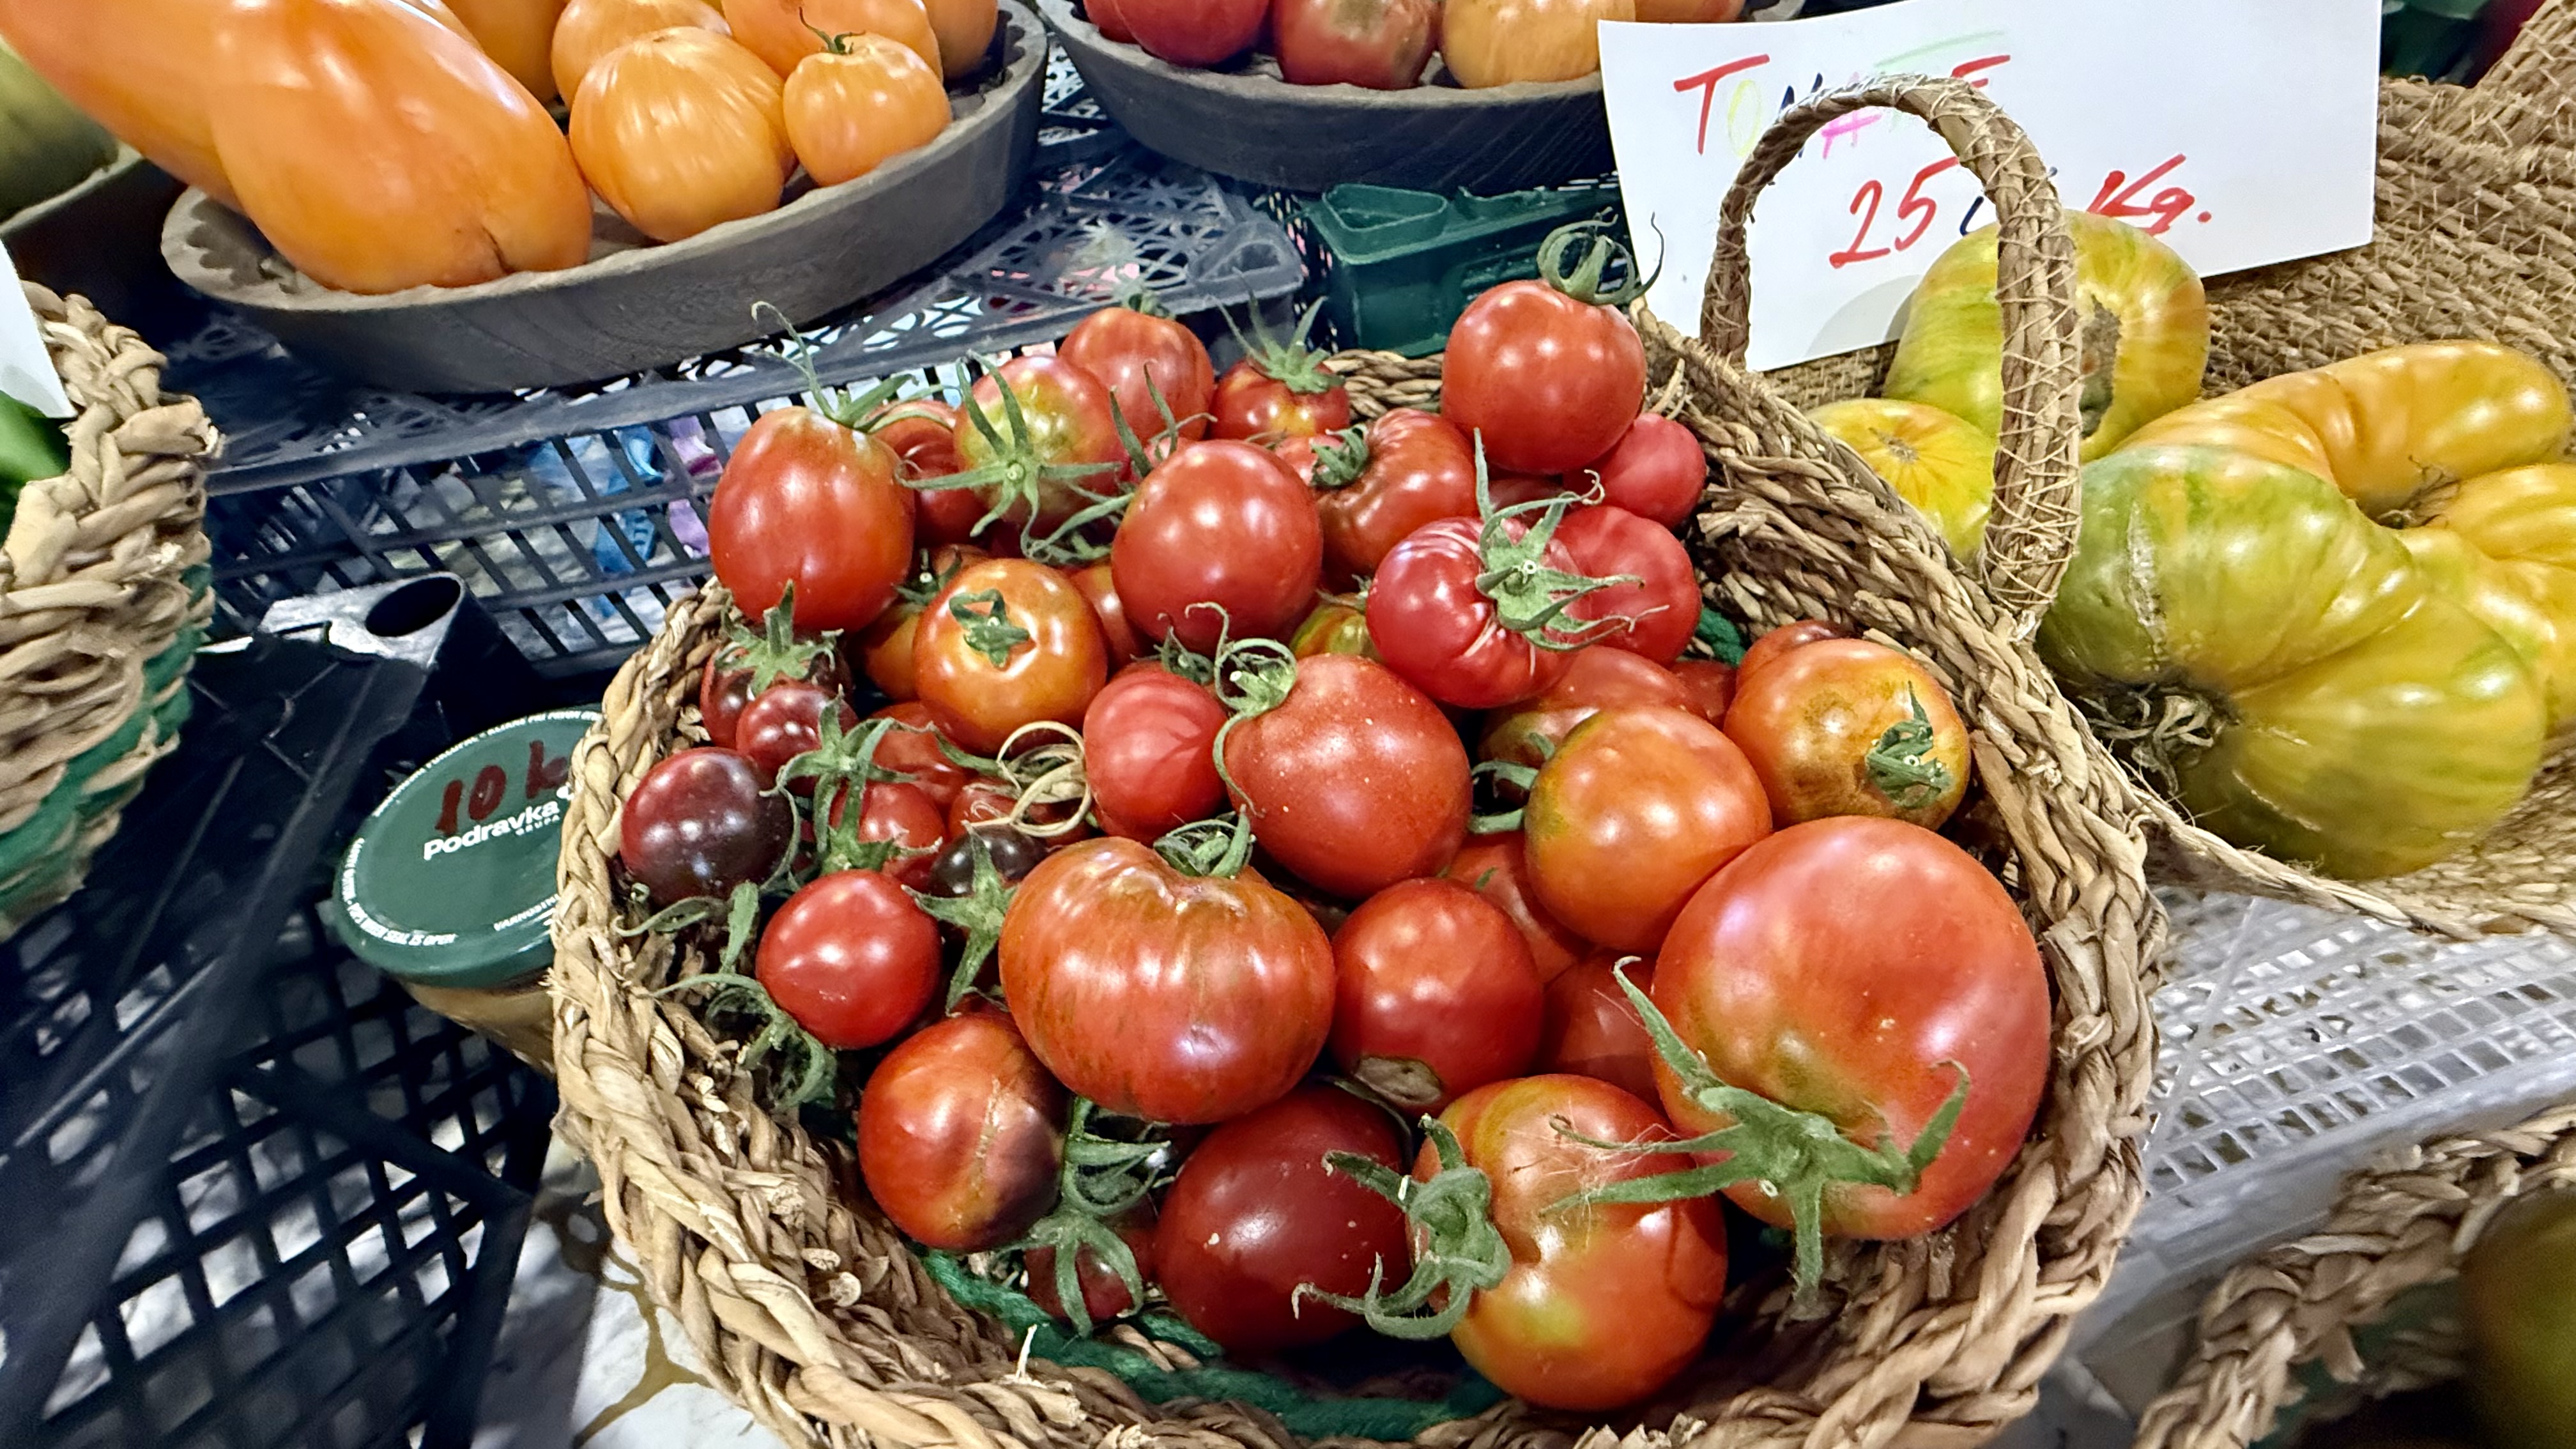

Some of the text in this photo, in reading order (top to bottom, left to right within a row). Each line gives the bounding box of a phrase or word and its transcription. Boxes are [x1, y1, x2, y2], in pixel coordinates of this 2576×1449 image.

[1829, 155, 1959, 269] 25
[424, 801, 560, 861] Podravka
[434, 764, 507, 836] 10
